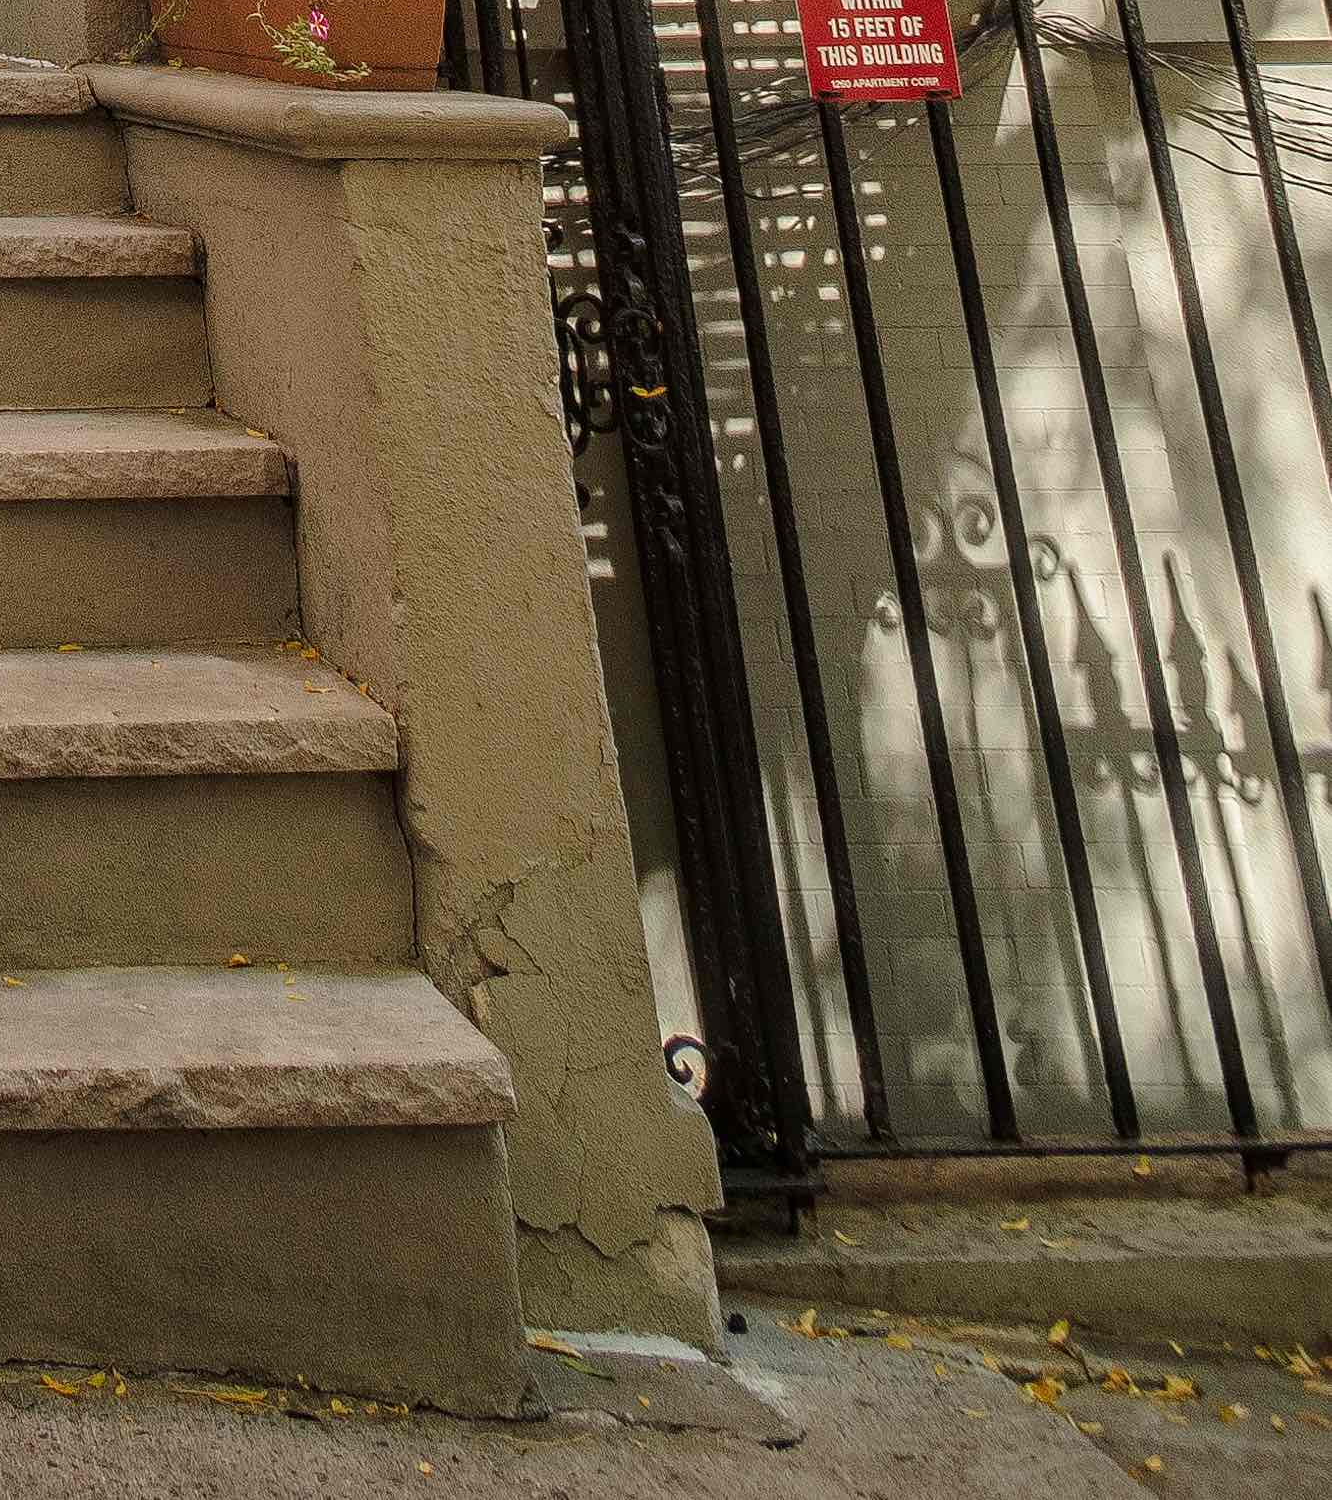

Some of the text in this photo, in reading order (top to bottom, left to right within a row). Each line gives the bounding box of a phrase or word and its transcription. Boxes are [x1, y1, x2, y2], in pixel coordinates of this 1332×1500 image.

[827, 16, 924, 39] 15 FEET OF
[817, 43, 944, 68] THIS BUILDING
[853, 77, 909, 88] APARTMENT
